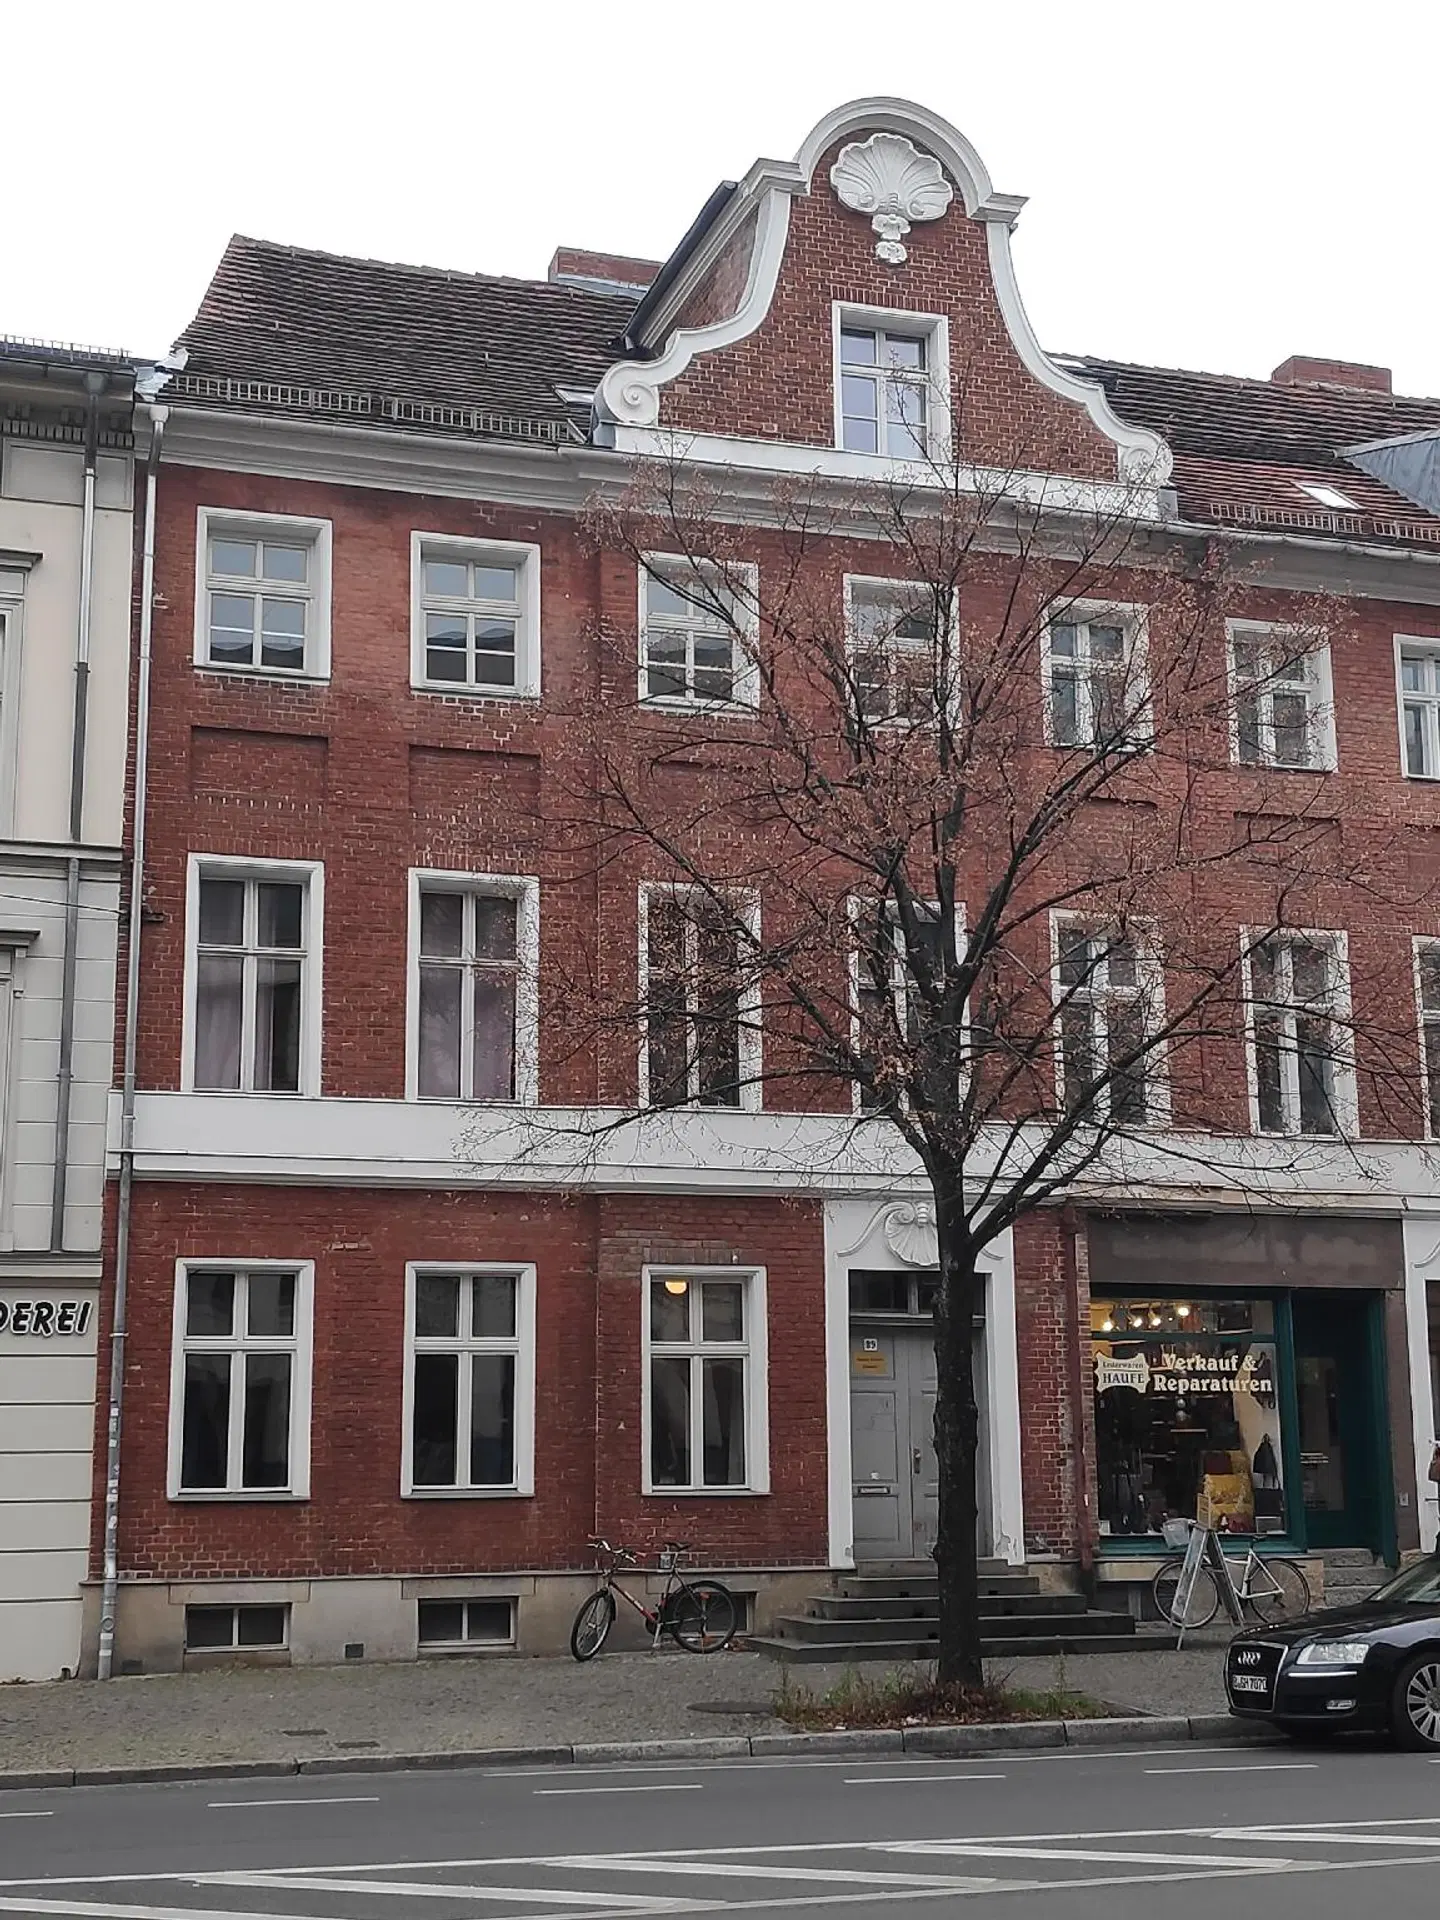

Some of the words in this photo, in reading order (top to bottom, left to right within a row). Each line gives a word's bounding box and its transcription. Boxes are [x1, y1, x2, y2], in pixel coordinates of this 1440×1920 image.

[1162, 1353, 1238, 1371] Verkauf
[1242, 1355, 1258, 1371] &
[1102, 1372, 1145, 1384] HAUFE
[1153, 1373, 1273, 1395] Reparaturen
